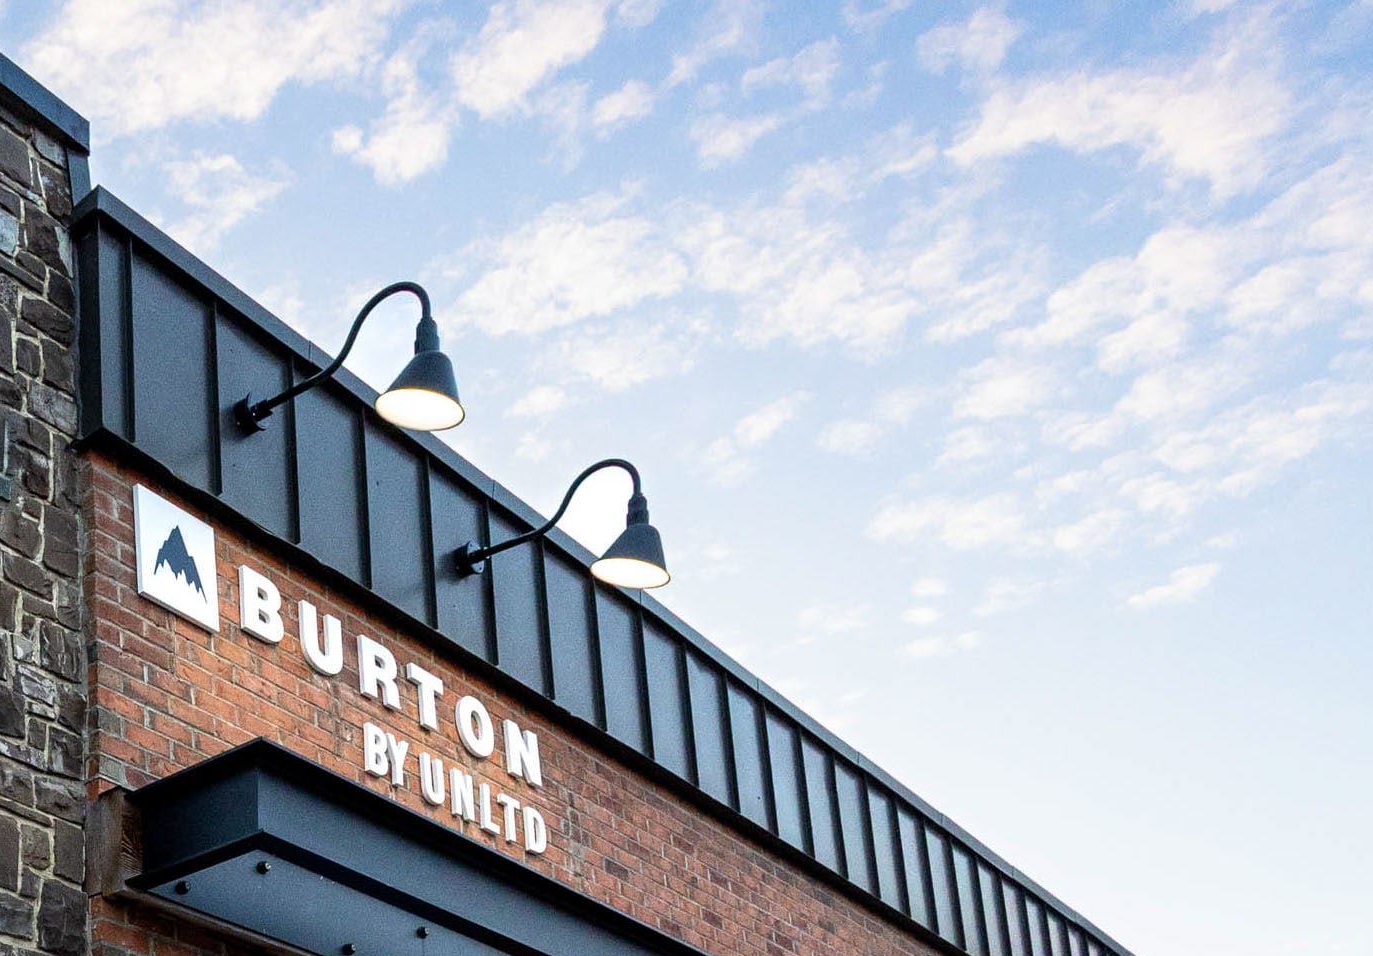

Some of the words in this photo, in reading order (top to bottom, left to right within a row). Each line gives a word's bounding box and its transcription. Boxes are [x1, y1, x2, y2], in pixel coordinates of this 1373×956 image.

[238, 564, 542, 787] BURTON
[363, 722, 409, 786] BY
[418, 752, 547, 855] UNLTD
